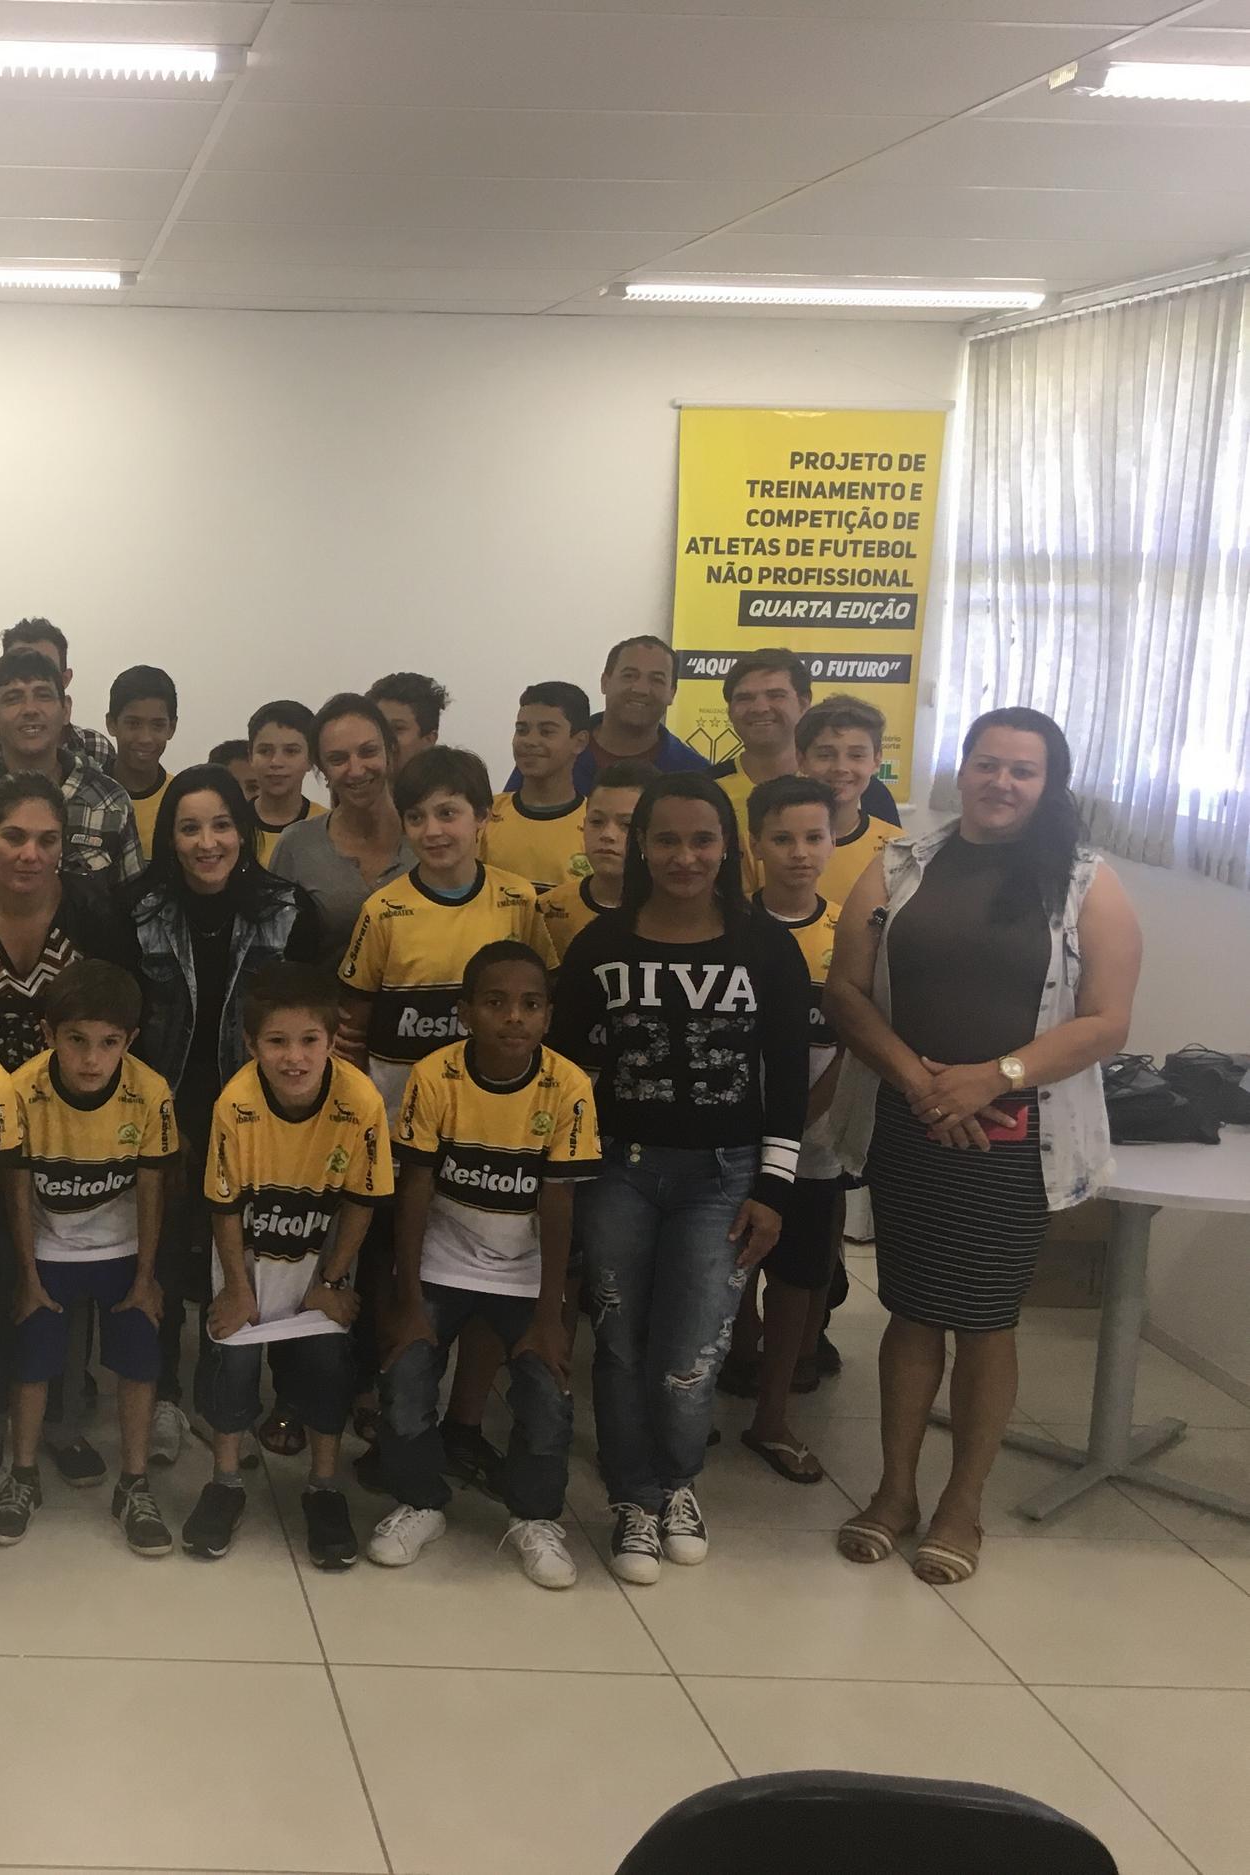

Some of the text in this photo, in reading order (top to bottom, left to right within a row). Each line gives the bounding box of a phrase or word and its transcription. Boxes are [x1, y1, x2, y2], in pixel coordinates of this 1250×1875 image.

[790, 451, 926, 472] PROJETO DE
[746, 479, 924, 501] TREINAMENTO E
[746, 506, 920, 535] COMPETIÇÃO DE
[685, 536, 917, 559] ATLETAS DE FUTEBOL
[706, 562, 913, 588] NÃO PROFISSIONAL
[749, 598, 911, 625] QUARTA EDIÇÃO
[810, 659, 824, 677] O
[593, 961, 758, 1012] DIVA
[397, 1006, 473, 1038] Resic
[612, 1012, 756, 1105] 25
[34, 1170, 136, 1197] Resicolor
[439, 1155, 539, 1194] Resicolo
